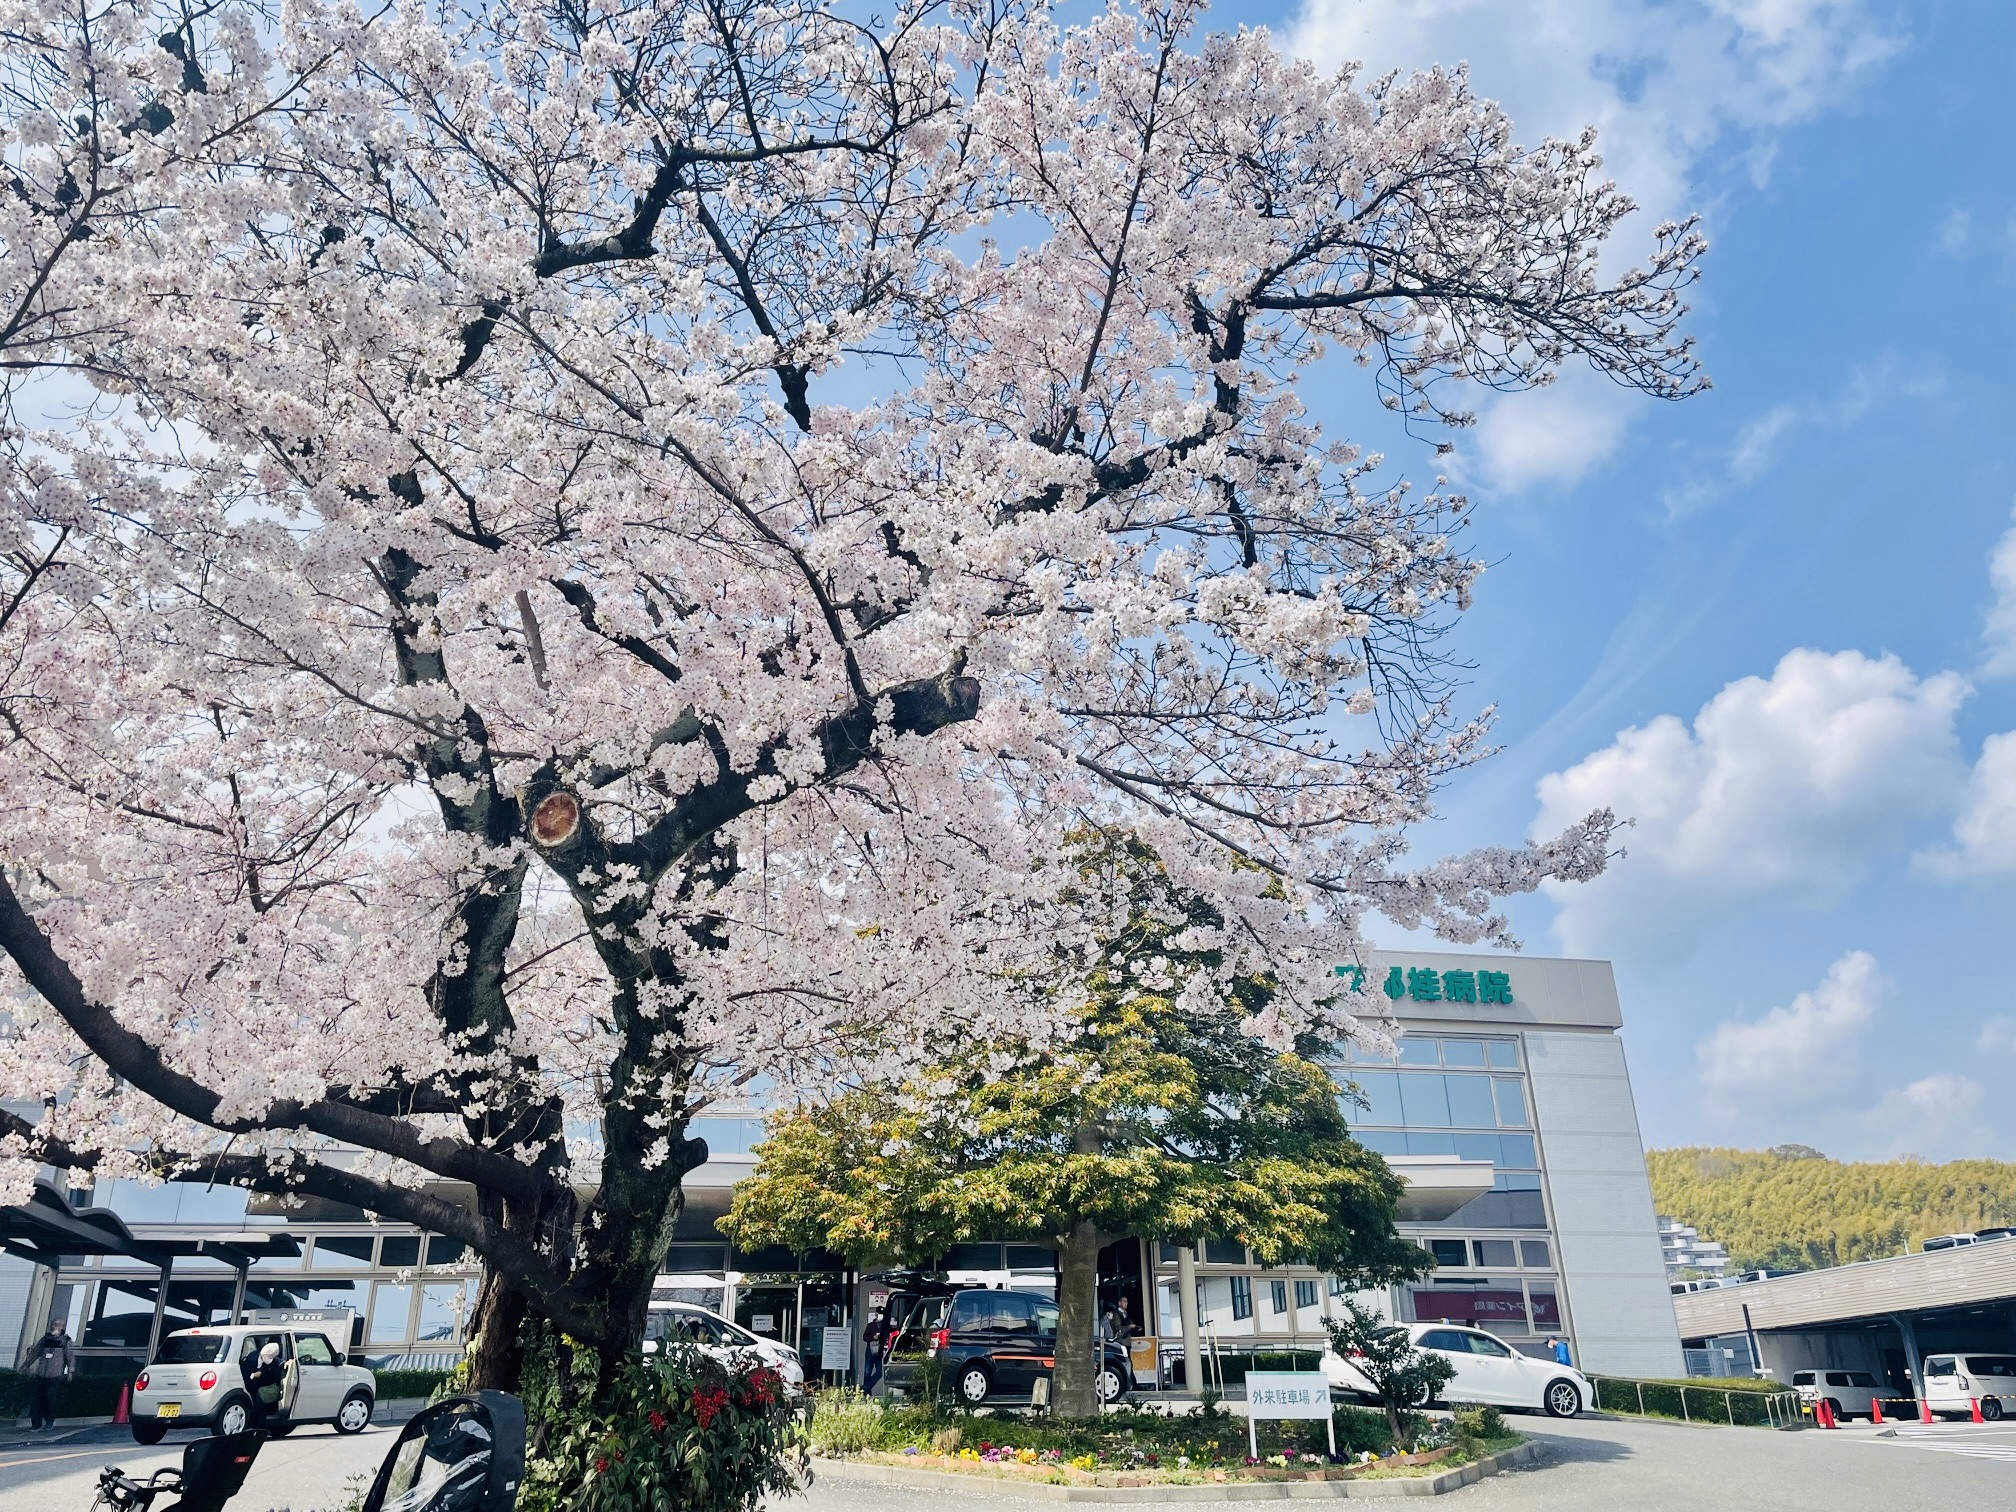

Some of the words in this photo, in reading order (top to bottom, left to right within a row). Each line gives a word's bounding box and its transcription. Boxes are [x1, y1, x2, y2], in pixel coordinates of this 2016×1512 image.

[1252, 1389, 1311, 1406] 外来駐車場
